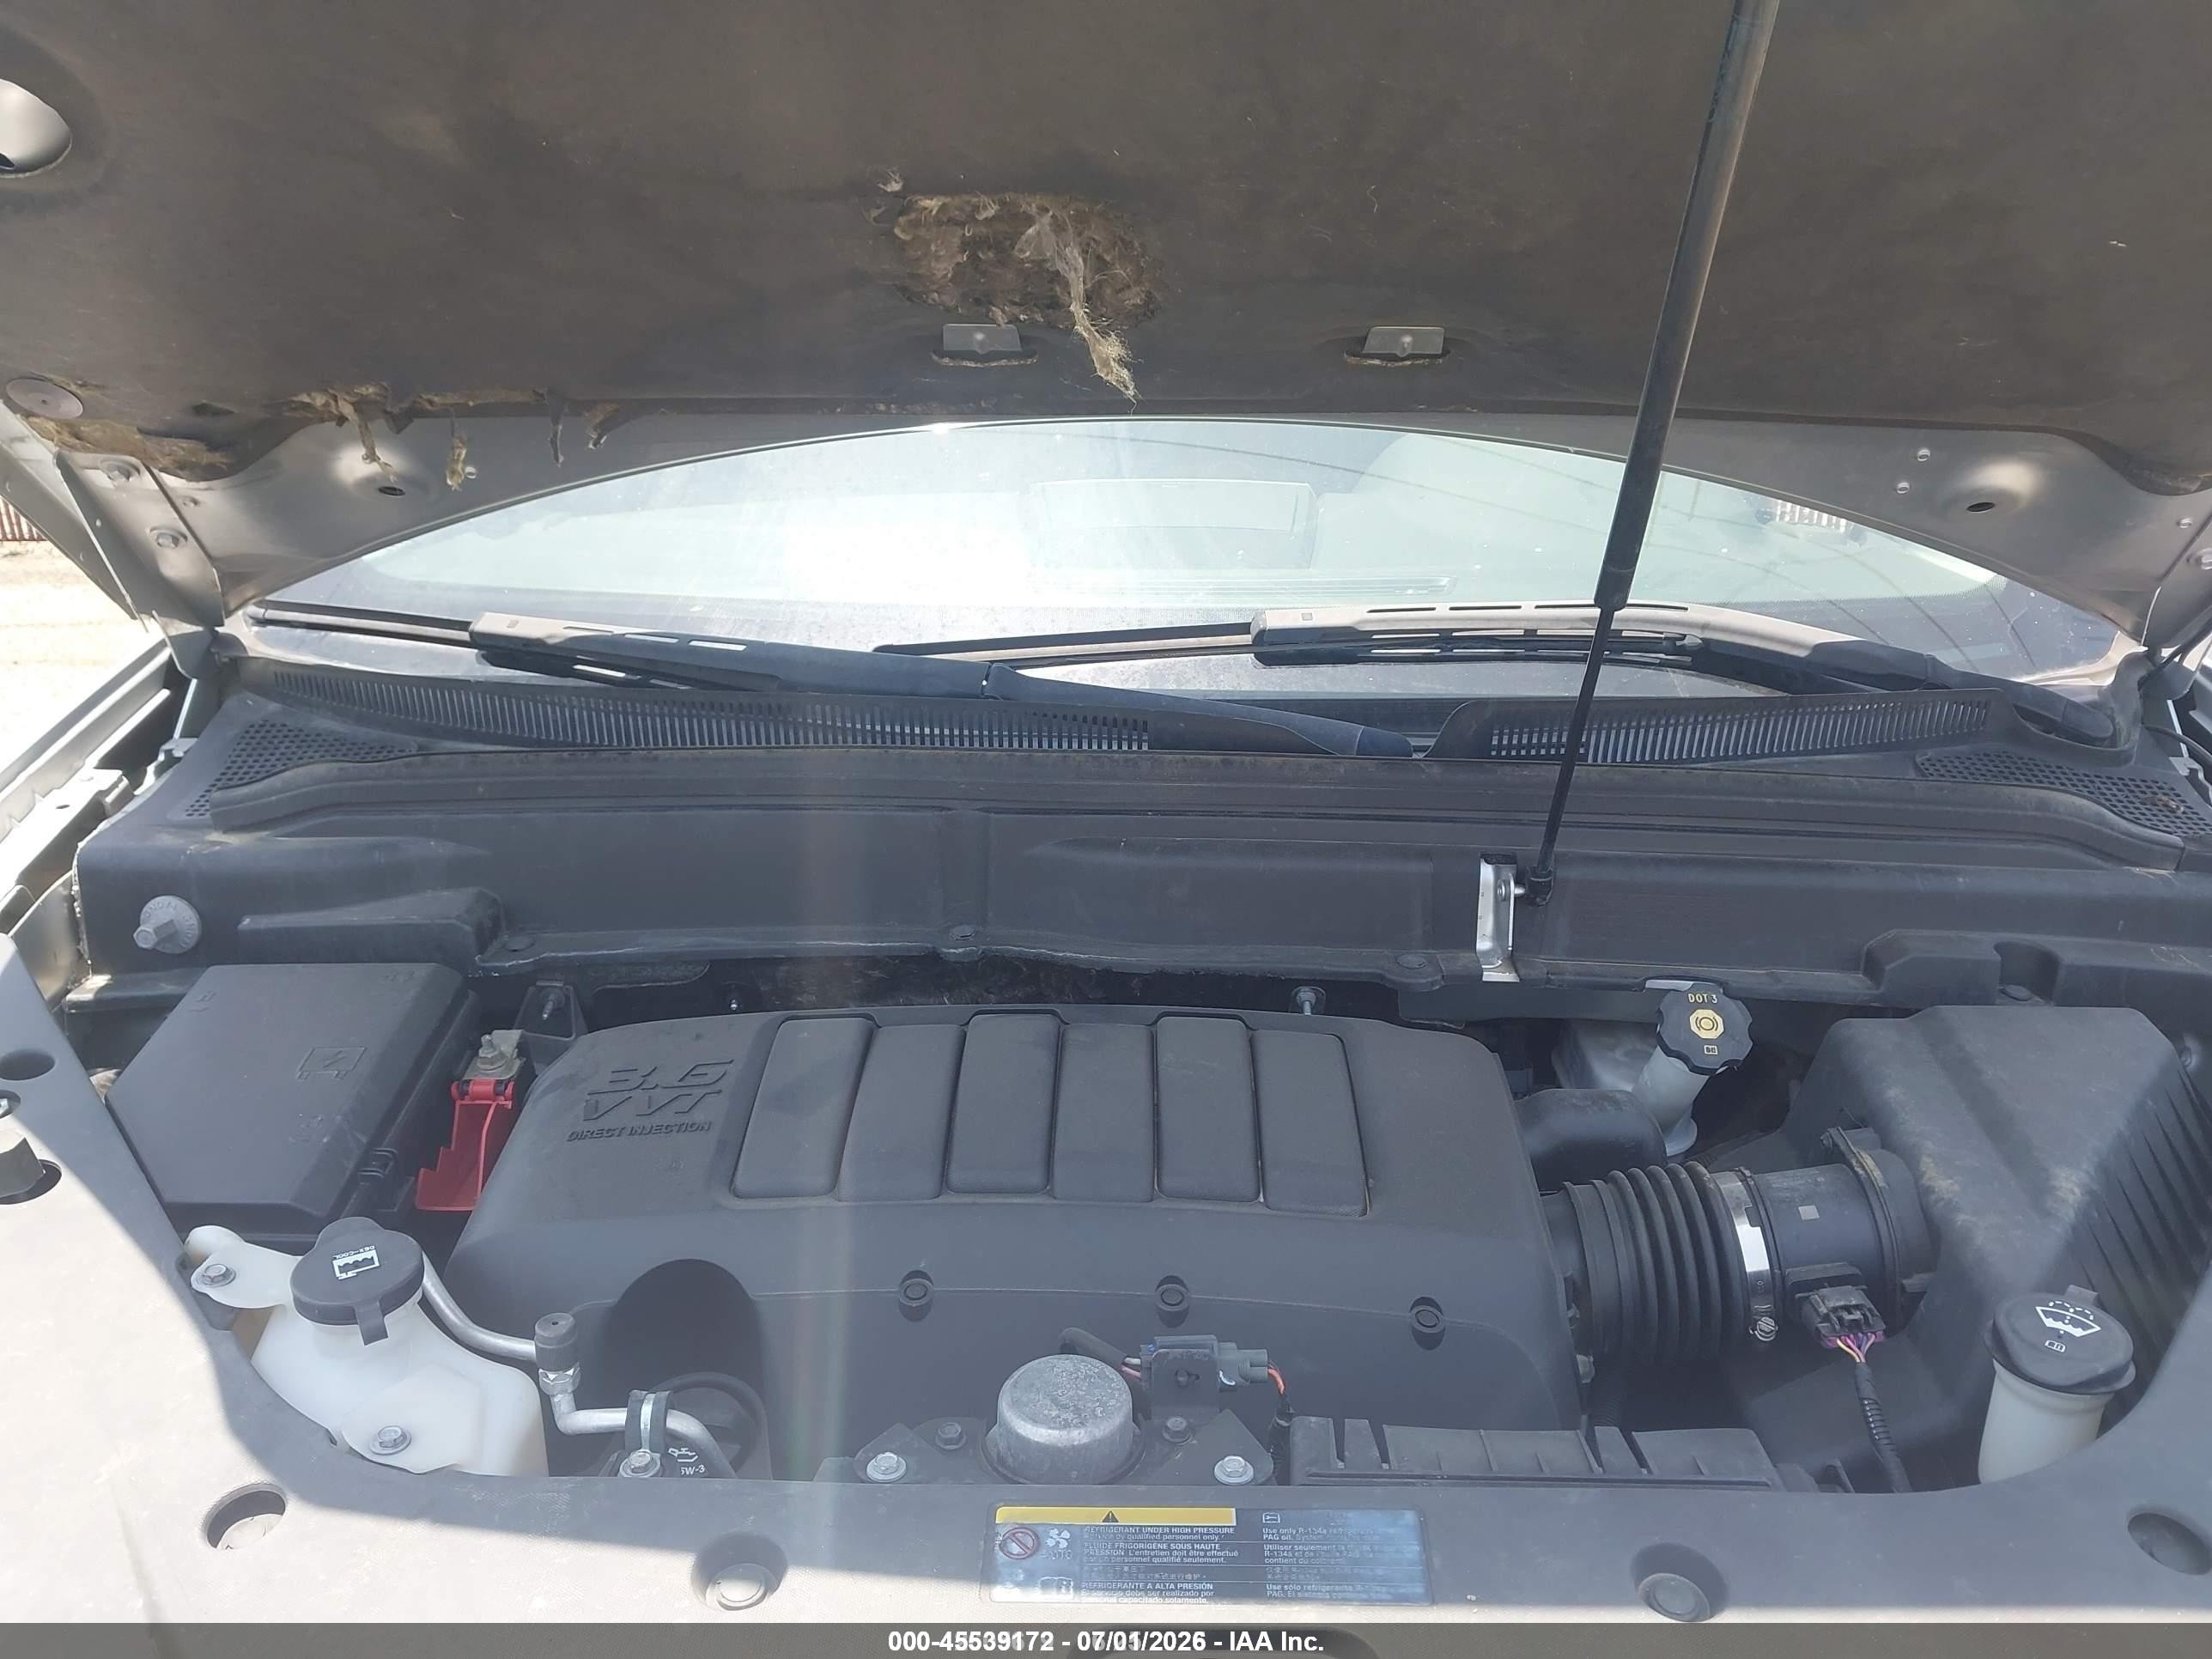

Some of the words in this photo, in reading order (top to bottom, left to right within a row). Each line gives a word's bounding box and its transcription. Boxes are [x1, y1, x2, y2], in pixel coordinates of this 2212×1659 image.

[1688, 994, 1708, 1003] DOT
[1711, 994, 1717, 1004] 3
[567, 1126, 625, 1142] DIRECT
[628, 1121, 712, 1135] INJECTION
[1177, 1582, 1213, 1590] PRESIÓN
